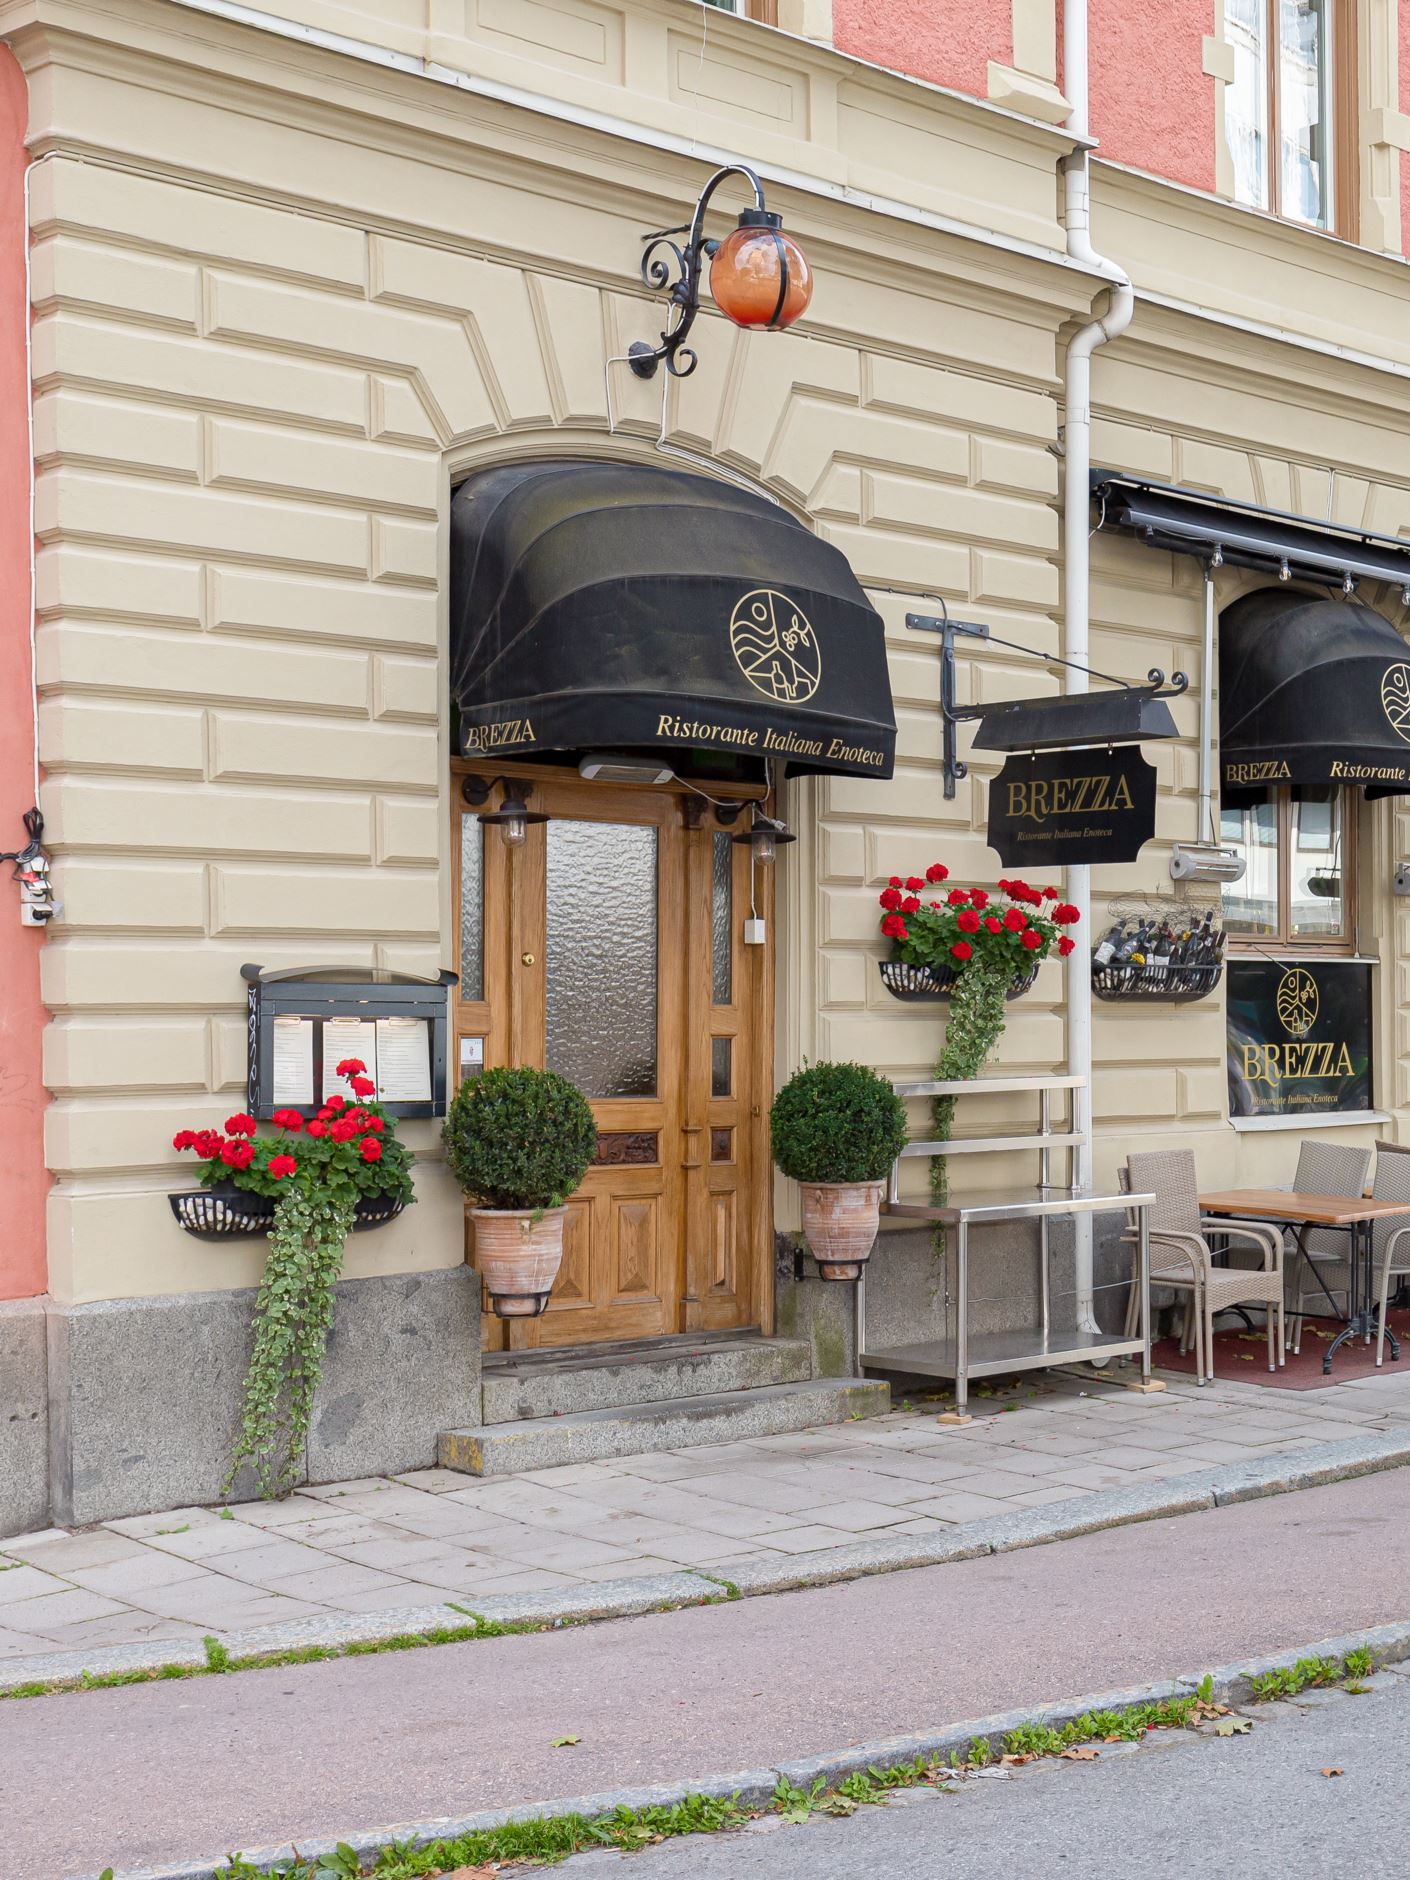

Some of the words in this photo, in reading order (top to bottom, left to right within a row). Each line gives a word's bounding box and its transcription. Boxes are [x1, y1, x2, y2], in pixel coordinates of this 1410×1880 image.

[464, 718, 537, 753] BREZZA
[656, 714, 758, 746] Ristorante
[762, 727, 823, 757] Italiana
[825, 738, 885, 767] Enoteca
[1226, 760, 1292, 784] BREZZA
[1329, 760, 1405, 780] Ristorante
[1006, 774, 1135, 823] BREZZA
[1017, 831, 1052, 841] Ristorante
[1054, 829, 1082, 839] Italiana
[1083, 827, 1113, 838] Enoteca
[1241, 1042, 1355, 1088] BREZZA
